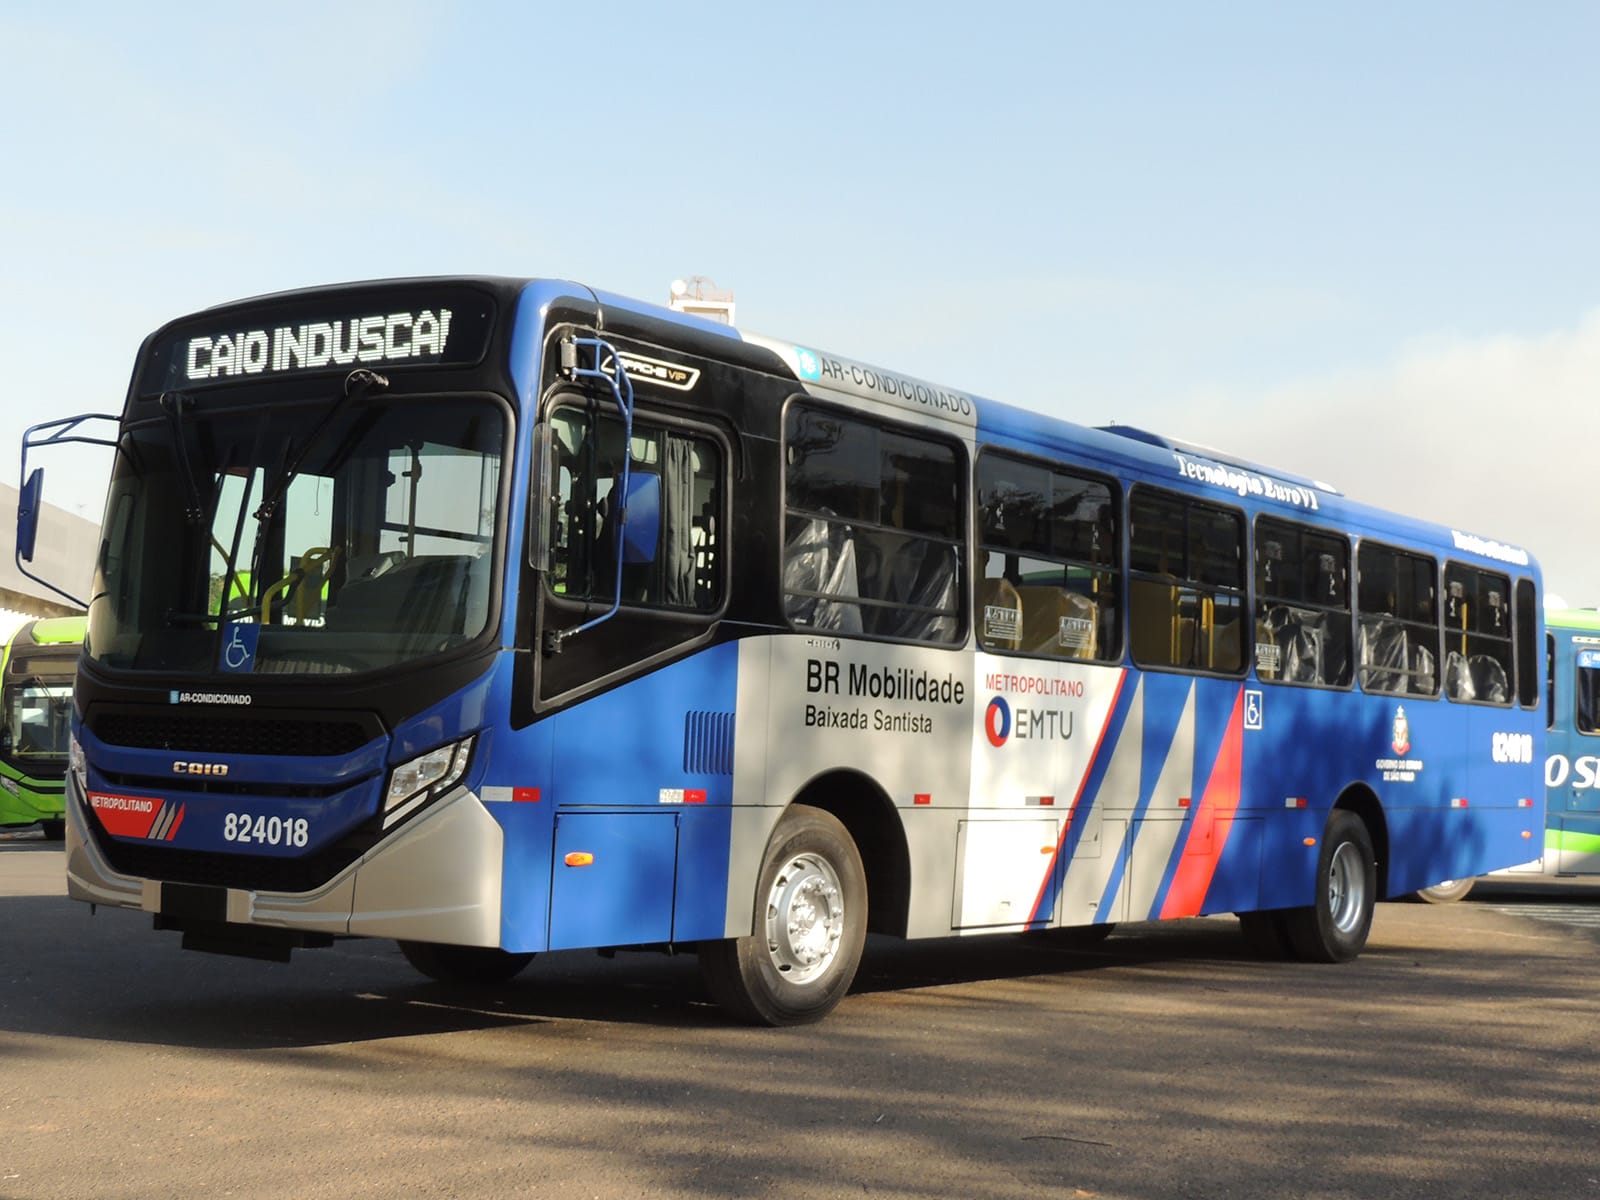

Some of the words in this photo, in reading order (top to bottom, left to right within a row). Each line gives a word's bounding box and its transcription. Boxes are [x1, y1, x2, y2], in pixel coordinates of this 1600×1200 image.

[186, 330, 269, 379] CAIO
[668, 370, 686, 381] VIP
[820, 357, 971, 416] AR-CONDICIONADO
[807, 659, 840, 695] BR
[848, 663, 965, 704] Mobilidade
[985, 673, 1085, 698] METROPOLITANO
[179, 692, 252, 705] AR-CONDICIONADO
[805, 704, 868, 730] Baixada
[873, 709, 933, 734] Santista
[1015, 708, 1074, 740] EMTU
[172, 761, 229, 776] CAIO
[223, 812, 309, 848] 824018
